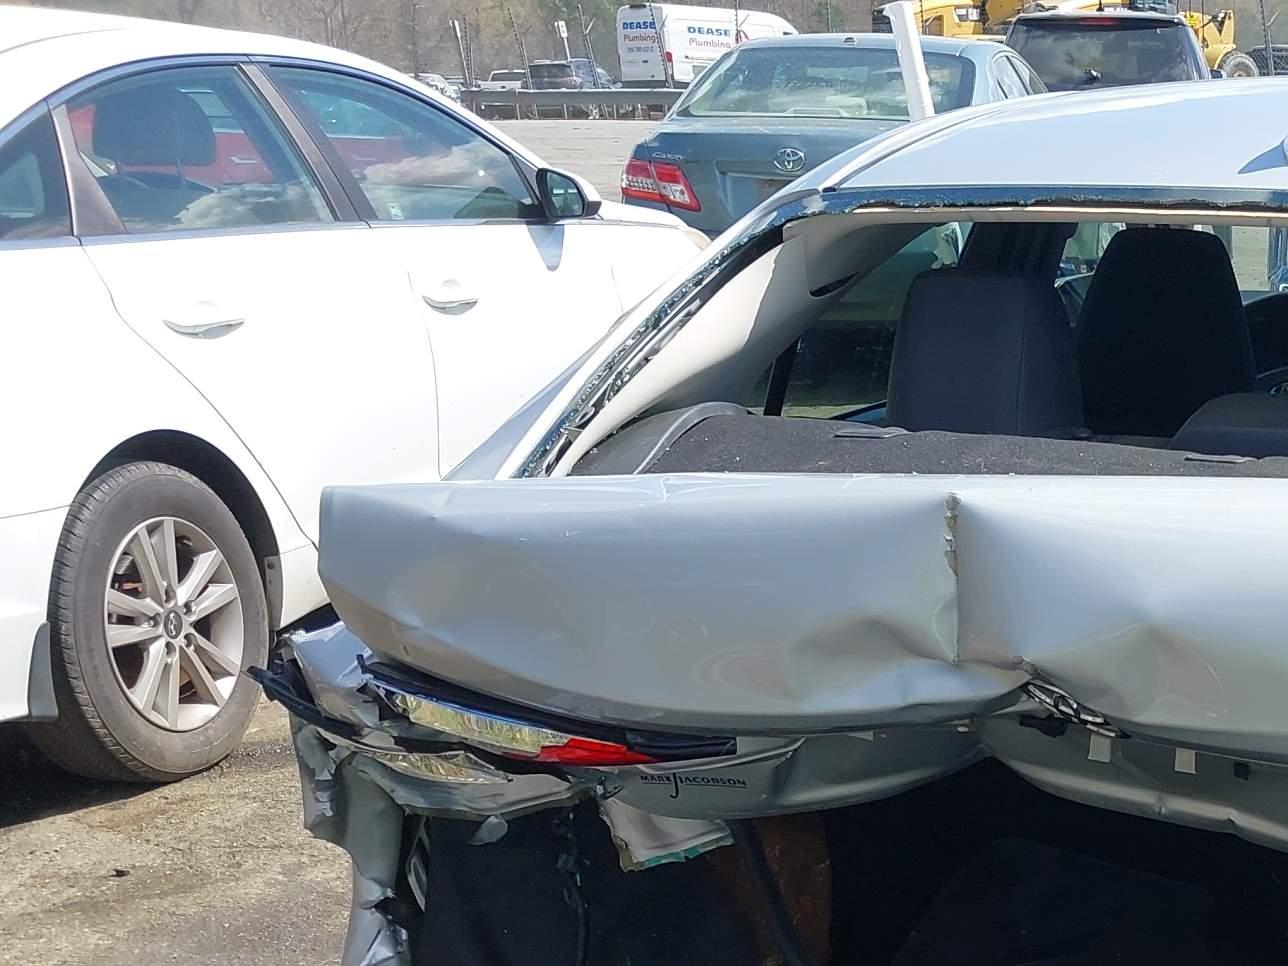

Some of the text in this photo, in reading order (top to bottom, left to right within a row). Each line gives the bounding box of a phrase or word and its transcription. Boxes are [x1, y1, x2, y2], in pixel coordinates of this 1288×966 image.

[622, 21, 656, 30] DEASE
[687, 26, 731, 37] DEASE
[623, 33, 657, 43] Plumbing
[640, 775, 672, 784] MARK
